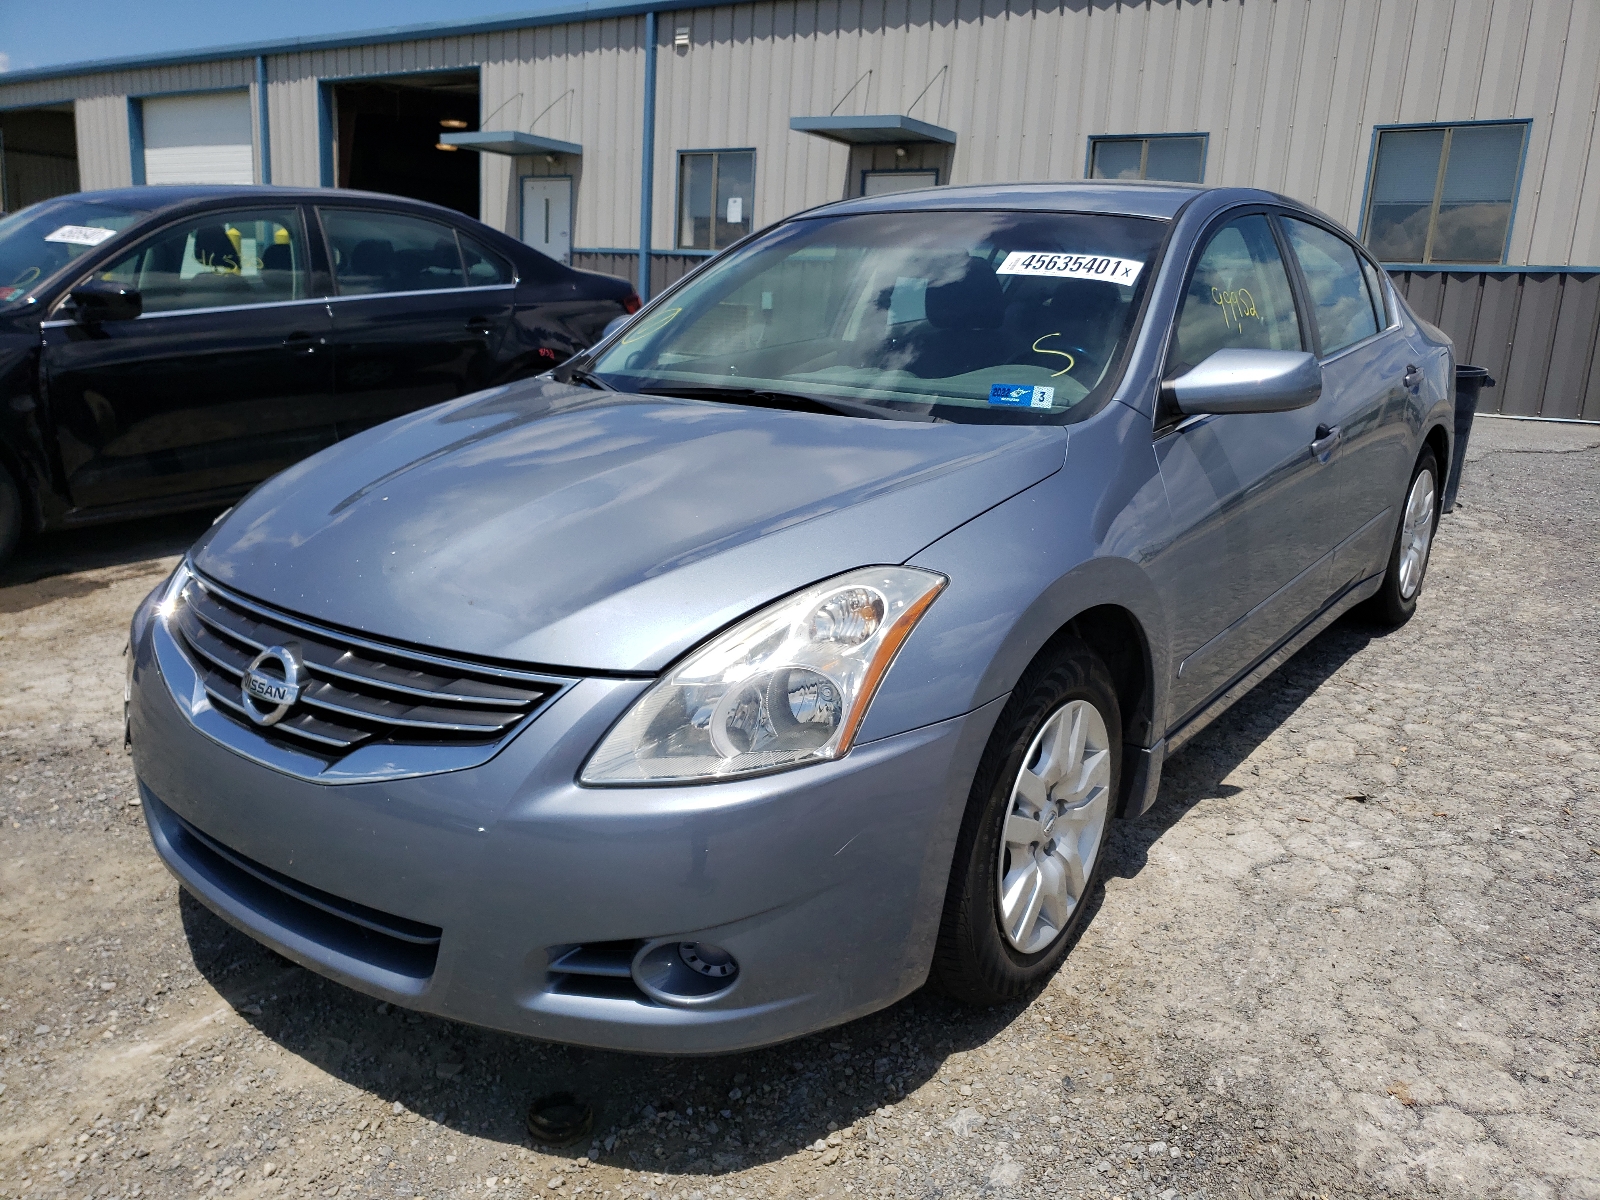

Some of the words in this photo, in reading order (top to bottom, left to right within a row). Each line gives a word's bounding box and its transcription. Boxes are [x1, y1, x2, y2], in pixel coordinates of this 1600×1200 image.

[1020, 254, 1122, 277] 45635401
[1038, 391, 1047, 403] 3
[244, 674, 287, 700] NISSAN
